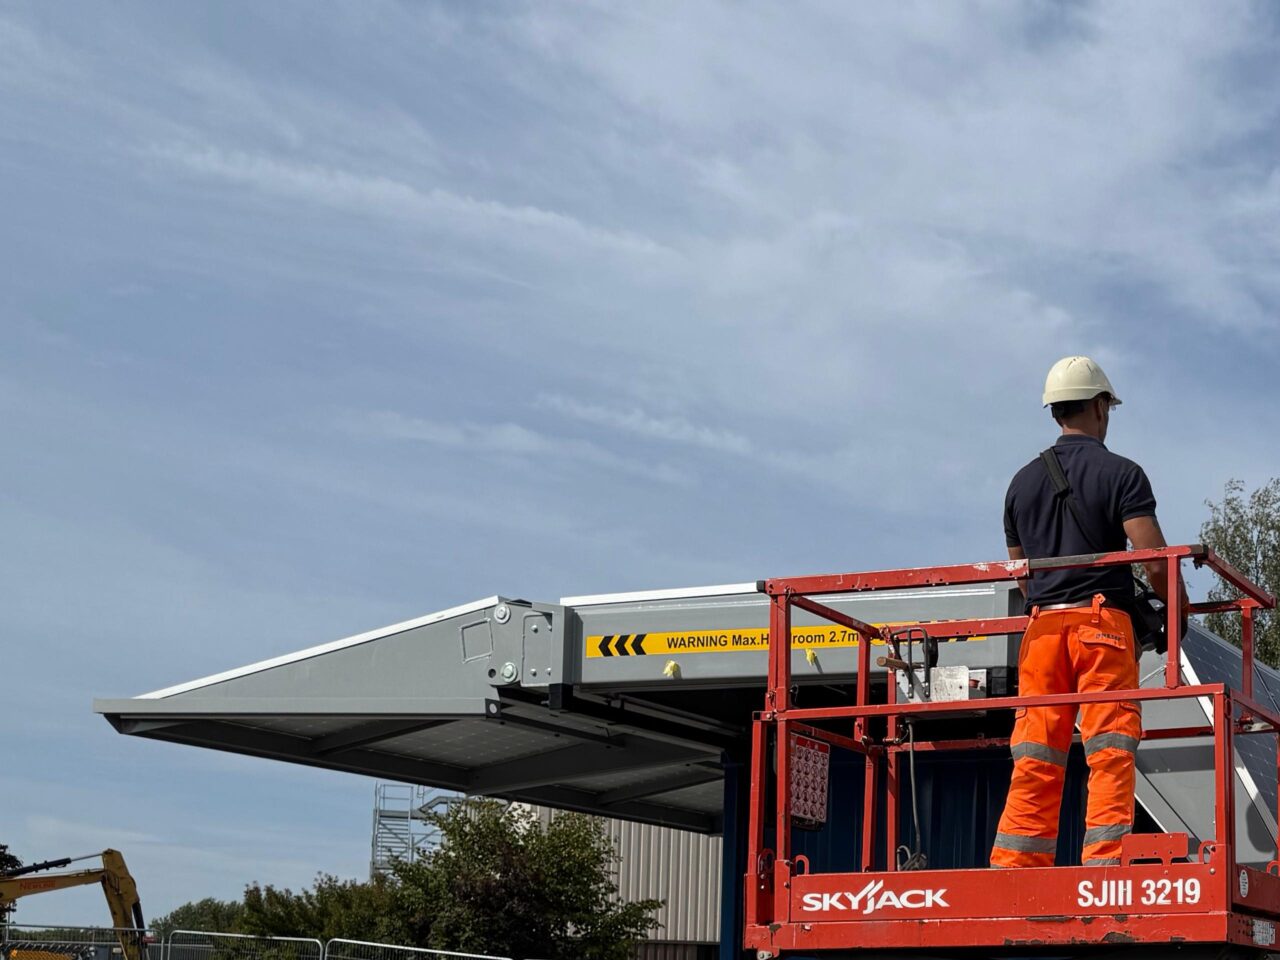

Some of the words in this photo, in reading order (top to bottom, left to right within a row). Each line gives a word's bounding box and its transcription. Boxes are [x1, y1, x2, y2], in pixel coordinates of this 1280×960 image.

[667, 634, 728, 649] WARNING
[732, 632, 825, 647] Max.Hroom
[802, 879, 950, 915] SKYJACK
[1140, 877, 1201, 905] 3219
